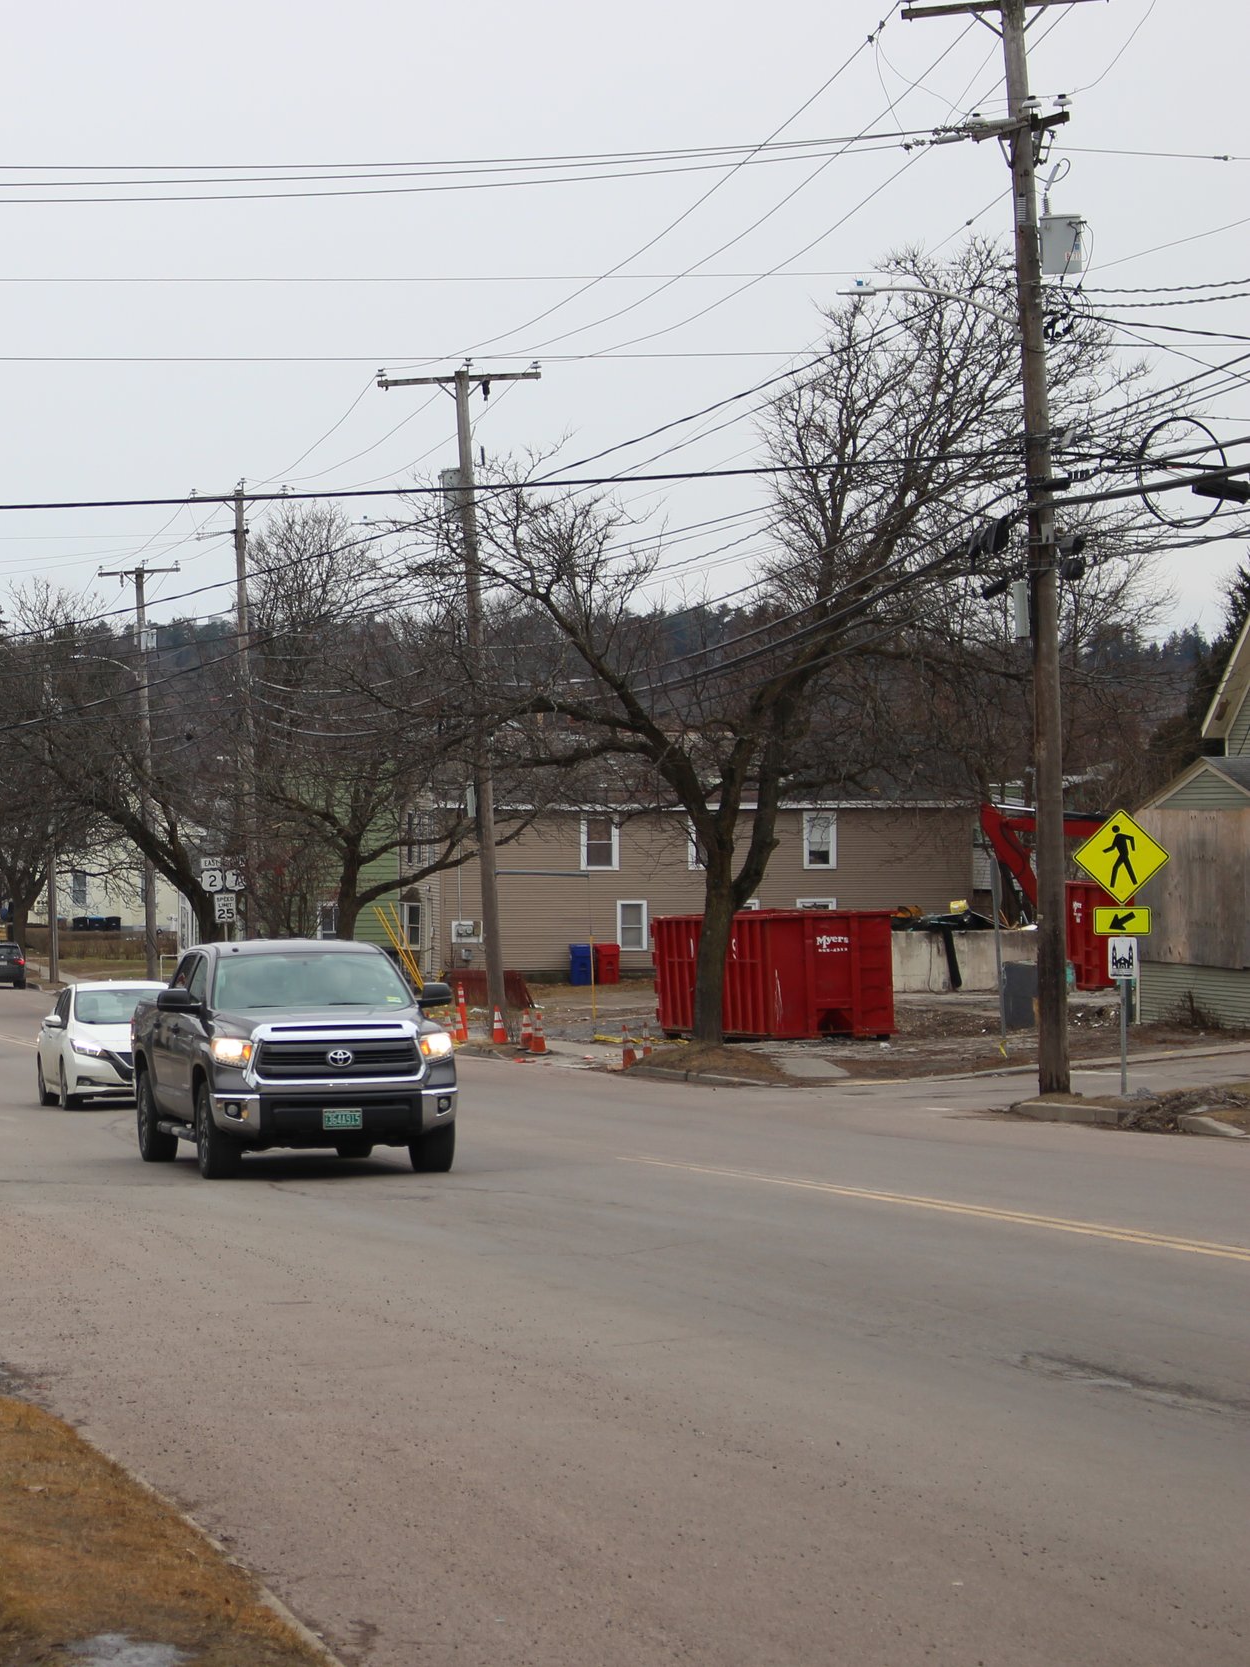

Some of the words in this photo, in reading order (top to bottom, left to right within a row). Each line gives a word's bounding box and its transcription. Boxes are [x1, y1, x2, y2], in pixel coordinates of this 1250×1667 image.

[209, 875, 217, 887] 2
[218, 909, 235, 919] 25
[816, 935, 848, 948] Myers
